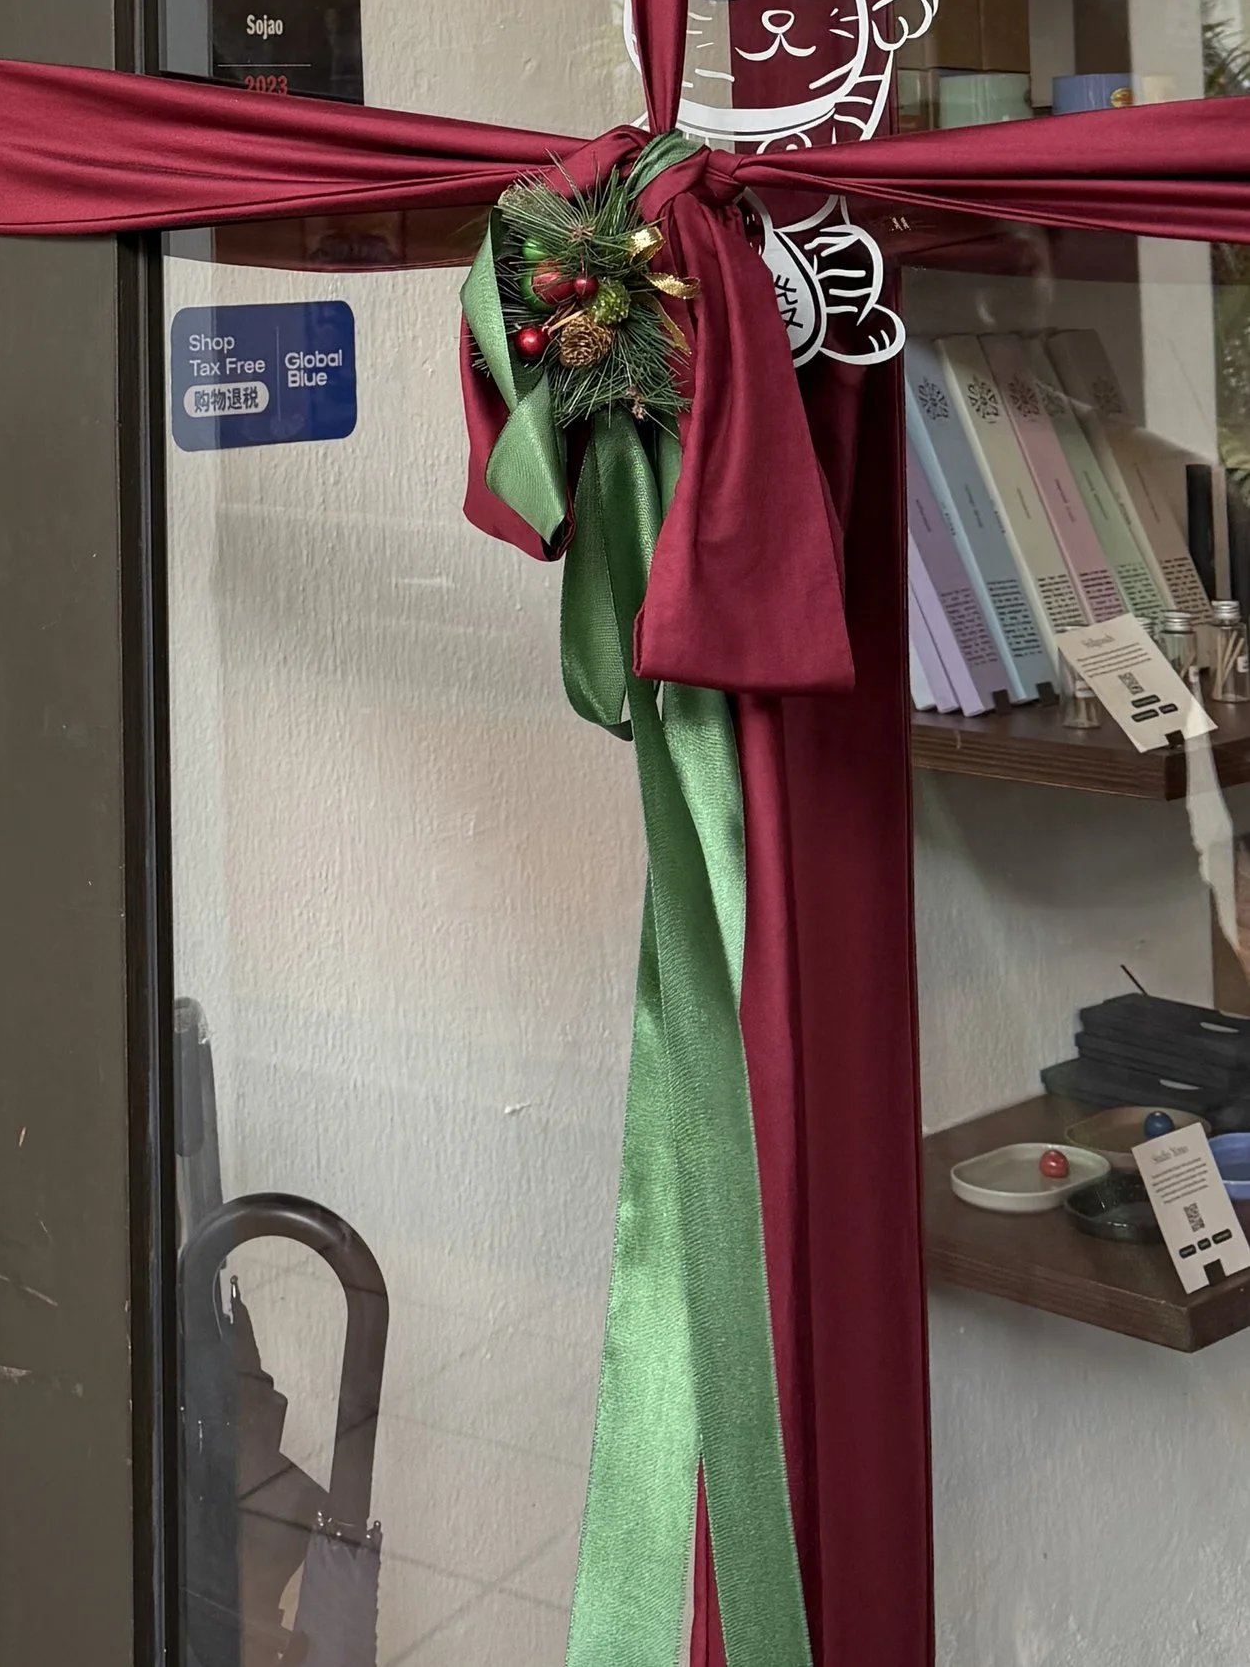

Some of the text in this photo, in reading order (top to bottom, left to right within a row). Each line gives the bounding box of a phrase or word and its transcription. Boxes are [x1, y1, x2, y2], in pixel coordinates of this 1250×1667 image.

[246, 14, 284, 40] Sojao
[244, 75, 288, 95] 2023
[188, 334, 235, 353] Shop
[189, 357, 266, 376] Tax Free
[284, 349, 343, 370] Global
[288, 369, 328, 388] Blue
[193, 386, 260, 413] 购物退税
